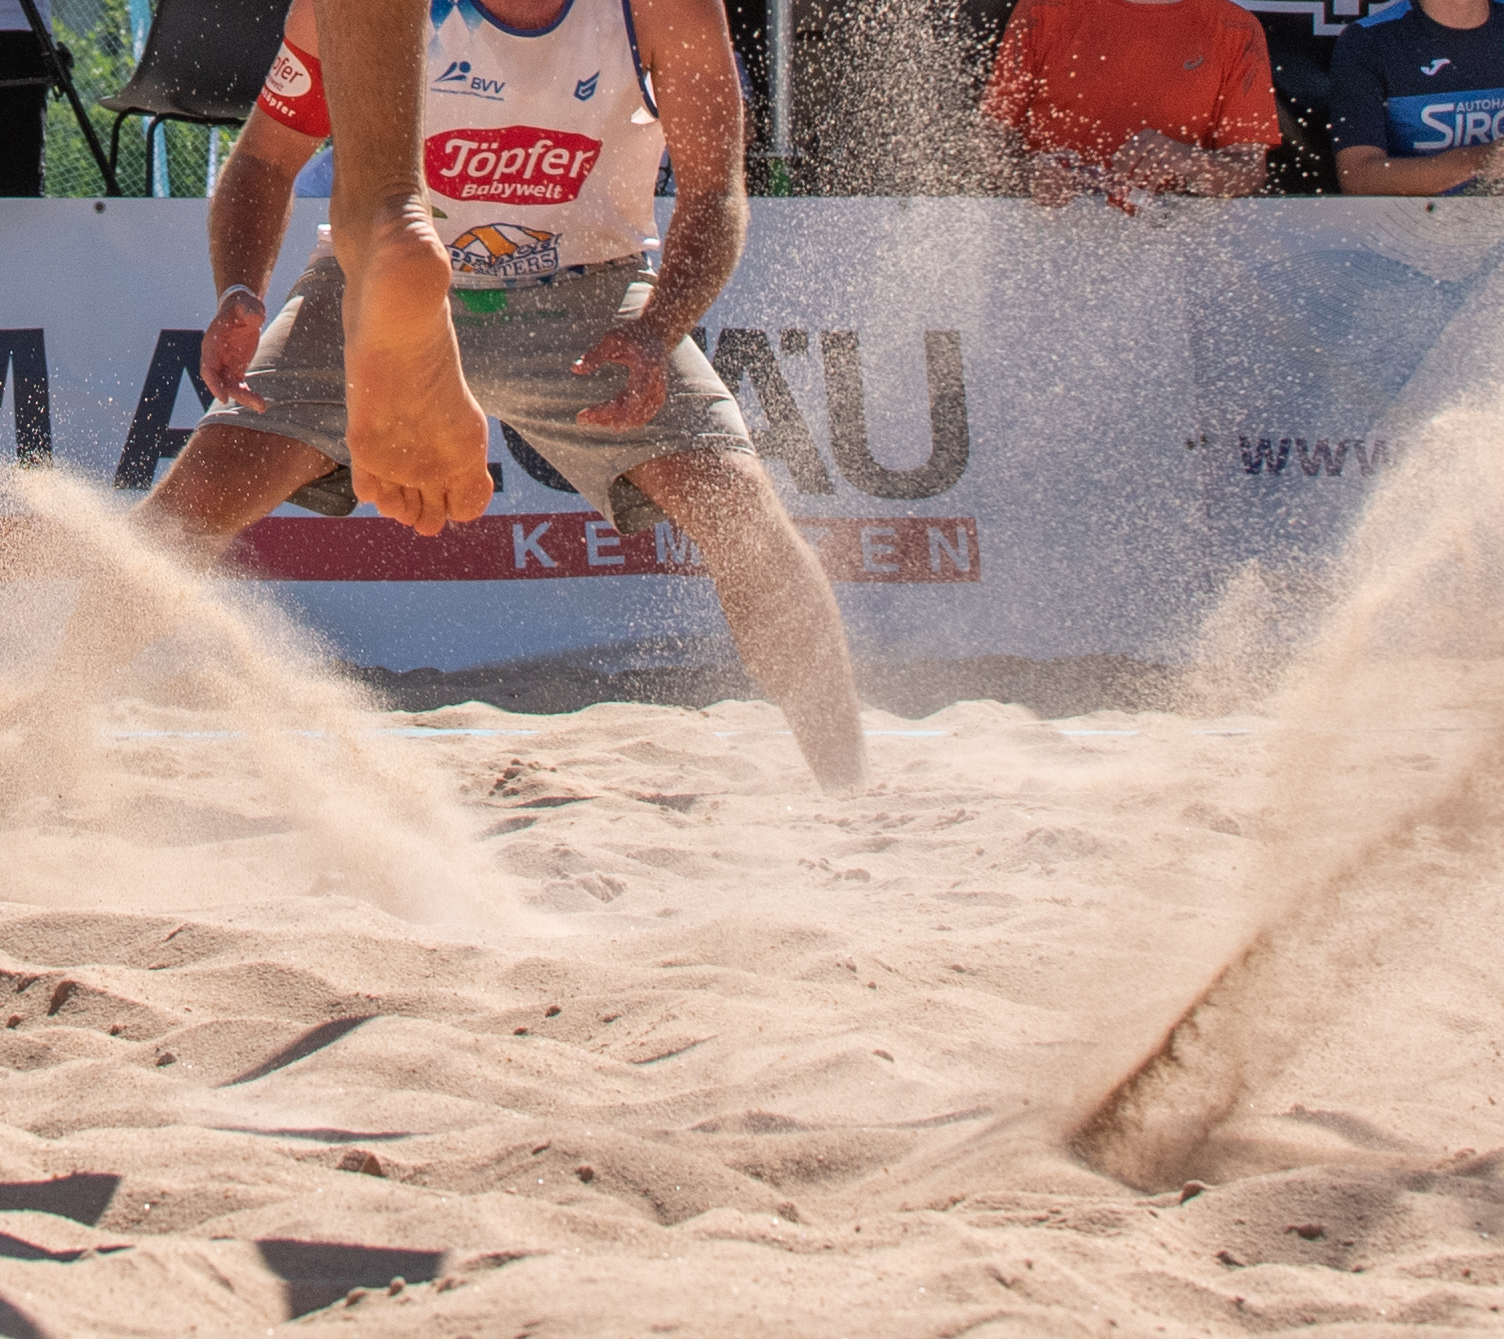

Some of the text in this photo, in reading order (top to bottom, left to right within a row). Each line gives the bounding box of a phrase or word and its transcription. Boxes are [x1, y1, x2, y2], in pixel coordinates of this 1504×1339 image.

[470, 76, 506, 94] BVV
[439, 138, 596, 180] Töpfer
[461, 181, 563, 200] Babywelt
[513, 521, 974, 571] KEMEN
